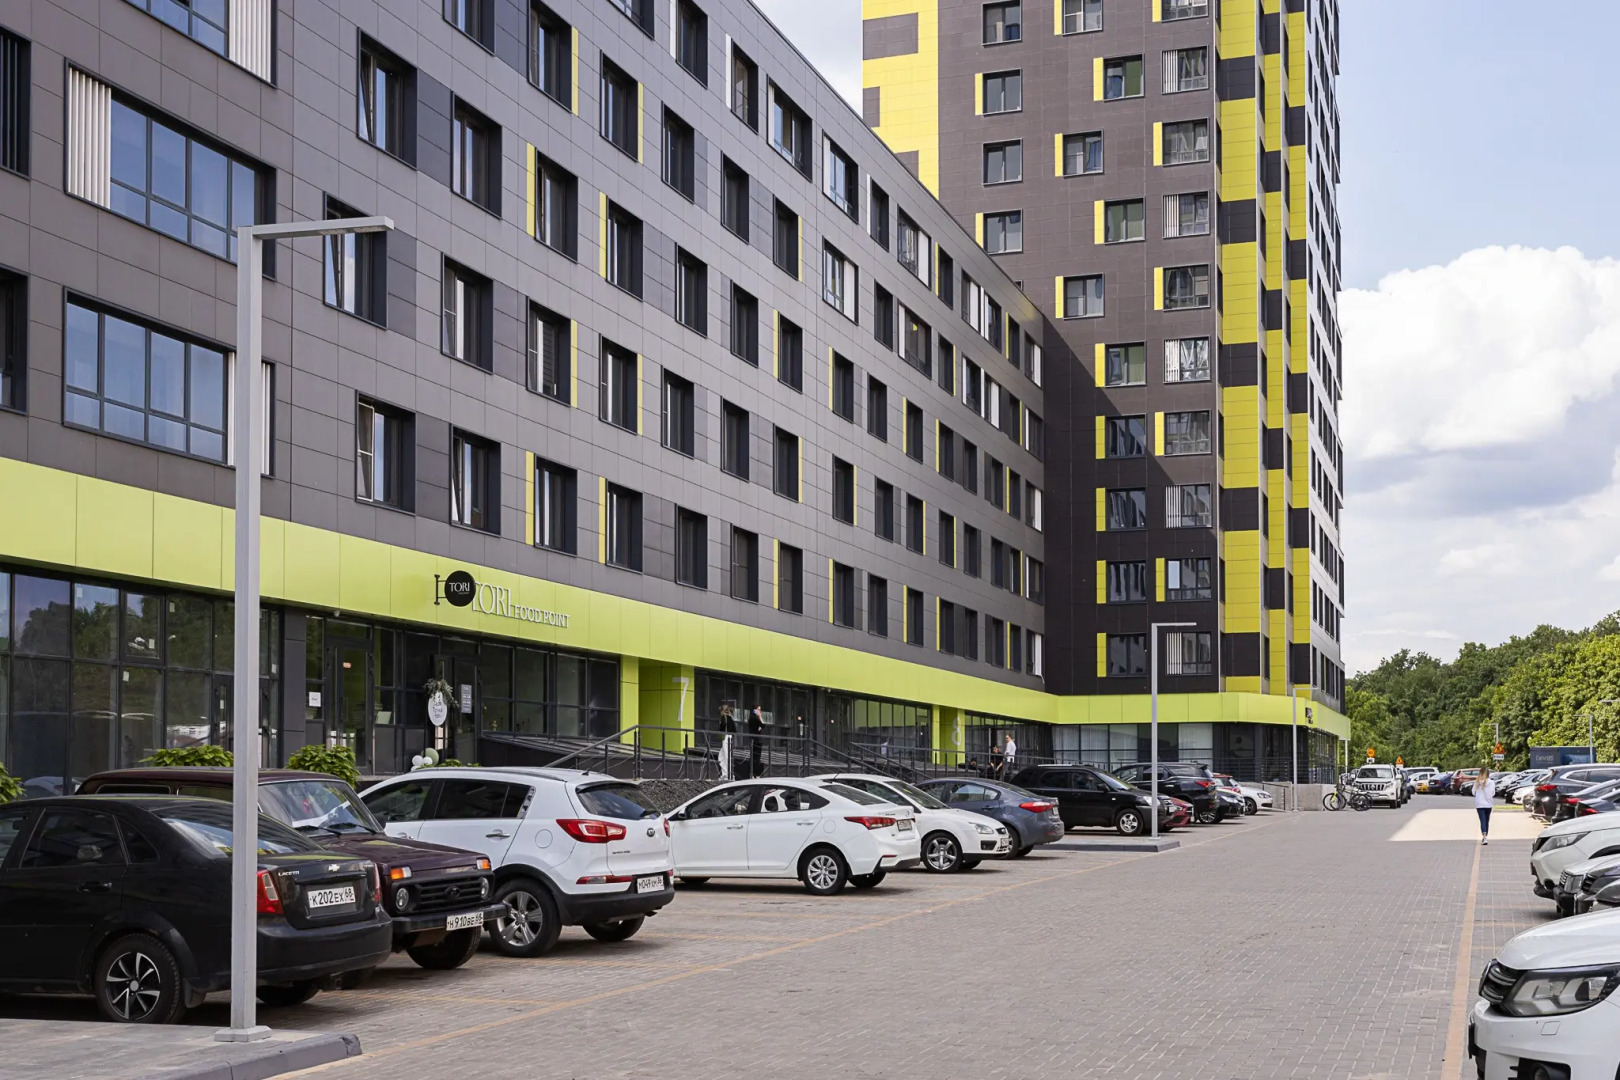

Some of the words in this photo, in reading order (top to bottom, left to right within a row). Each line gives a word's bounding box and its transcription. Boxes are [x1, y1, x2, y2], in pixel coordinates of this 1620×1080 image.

[449, 582, 470, 592] TORI
[514, 605, 541, 623] FOOD
[543, 610, 569, 628] POINT
[672, 677, 689, 721] 7
[952, 716, 962, 746] 8
